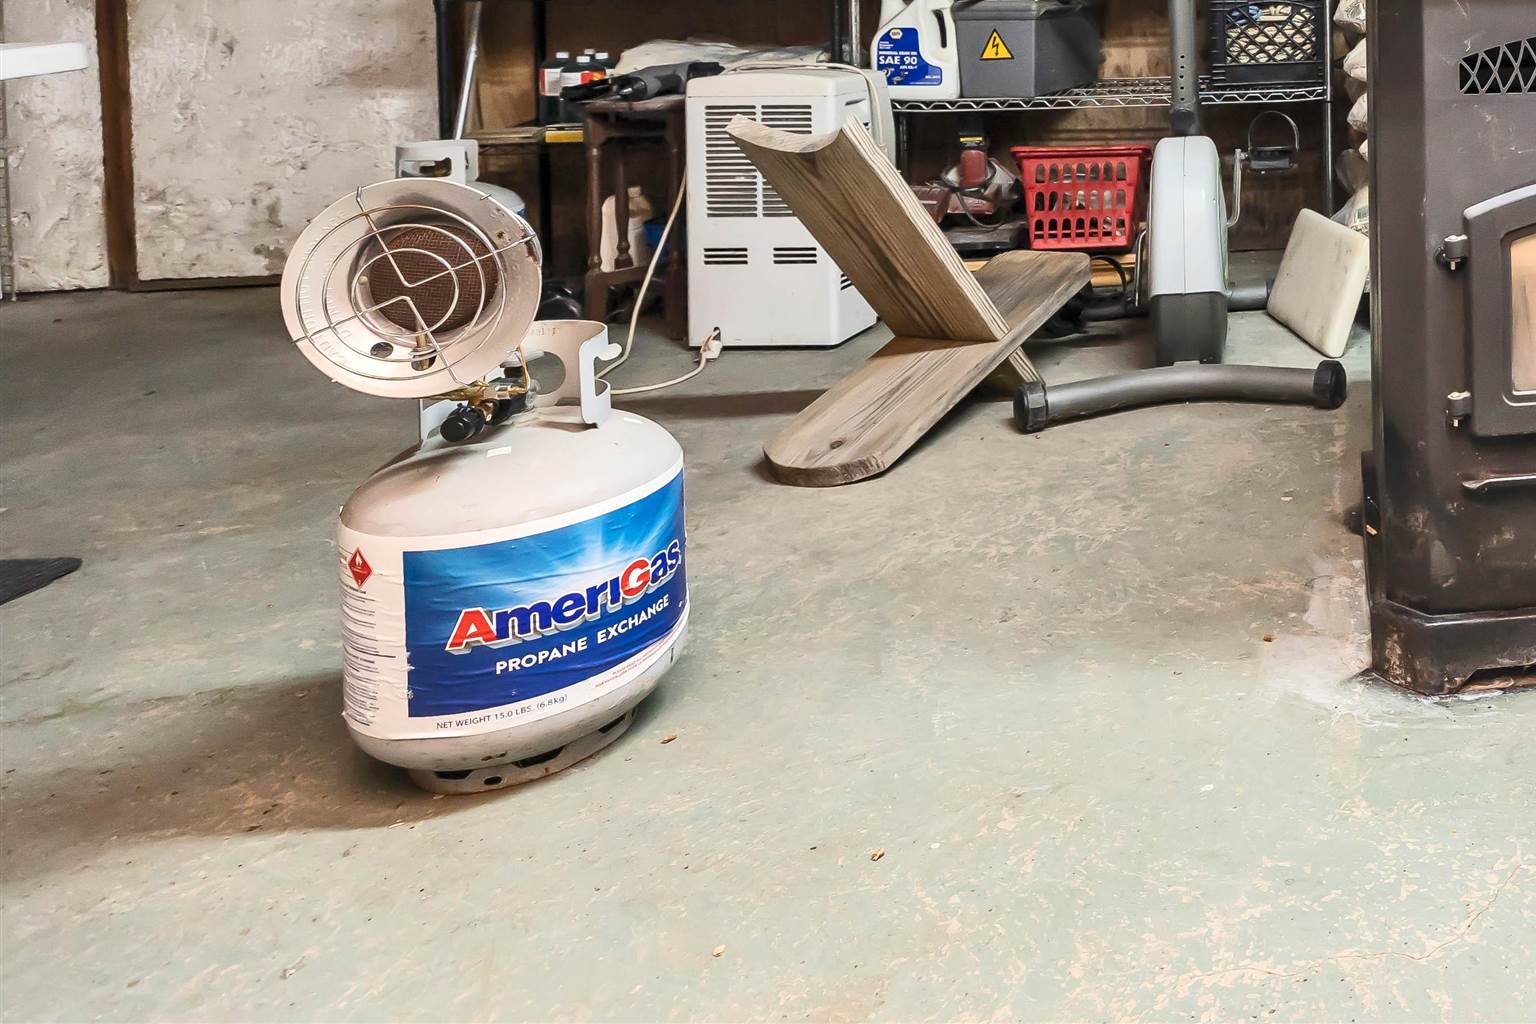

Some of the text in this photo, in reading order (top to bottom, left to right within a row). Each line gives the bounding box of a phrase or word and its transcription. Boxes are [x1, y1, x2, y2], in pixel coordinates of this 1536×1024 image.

[879, 56, 917, 65] SAE 90
[445, 539, 682, 653] AmeriGas
[496, 637, 588, 675] PROPANE
[597, 593, 669, 644] EXCHANGE
[436, 721, 452, 729] NET
[455, 715, 491, 727] WEIGHT
[495, 711, 513, 720] 15.0
